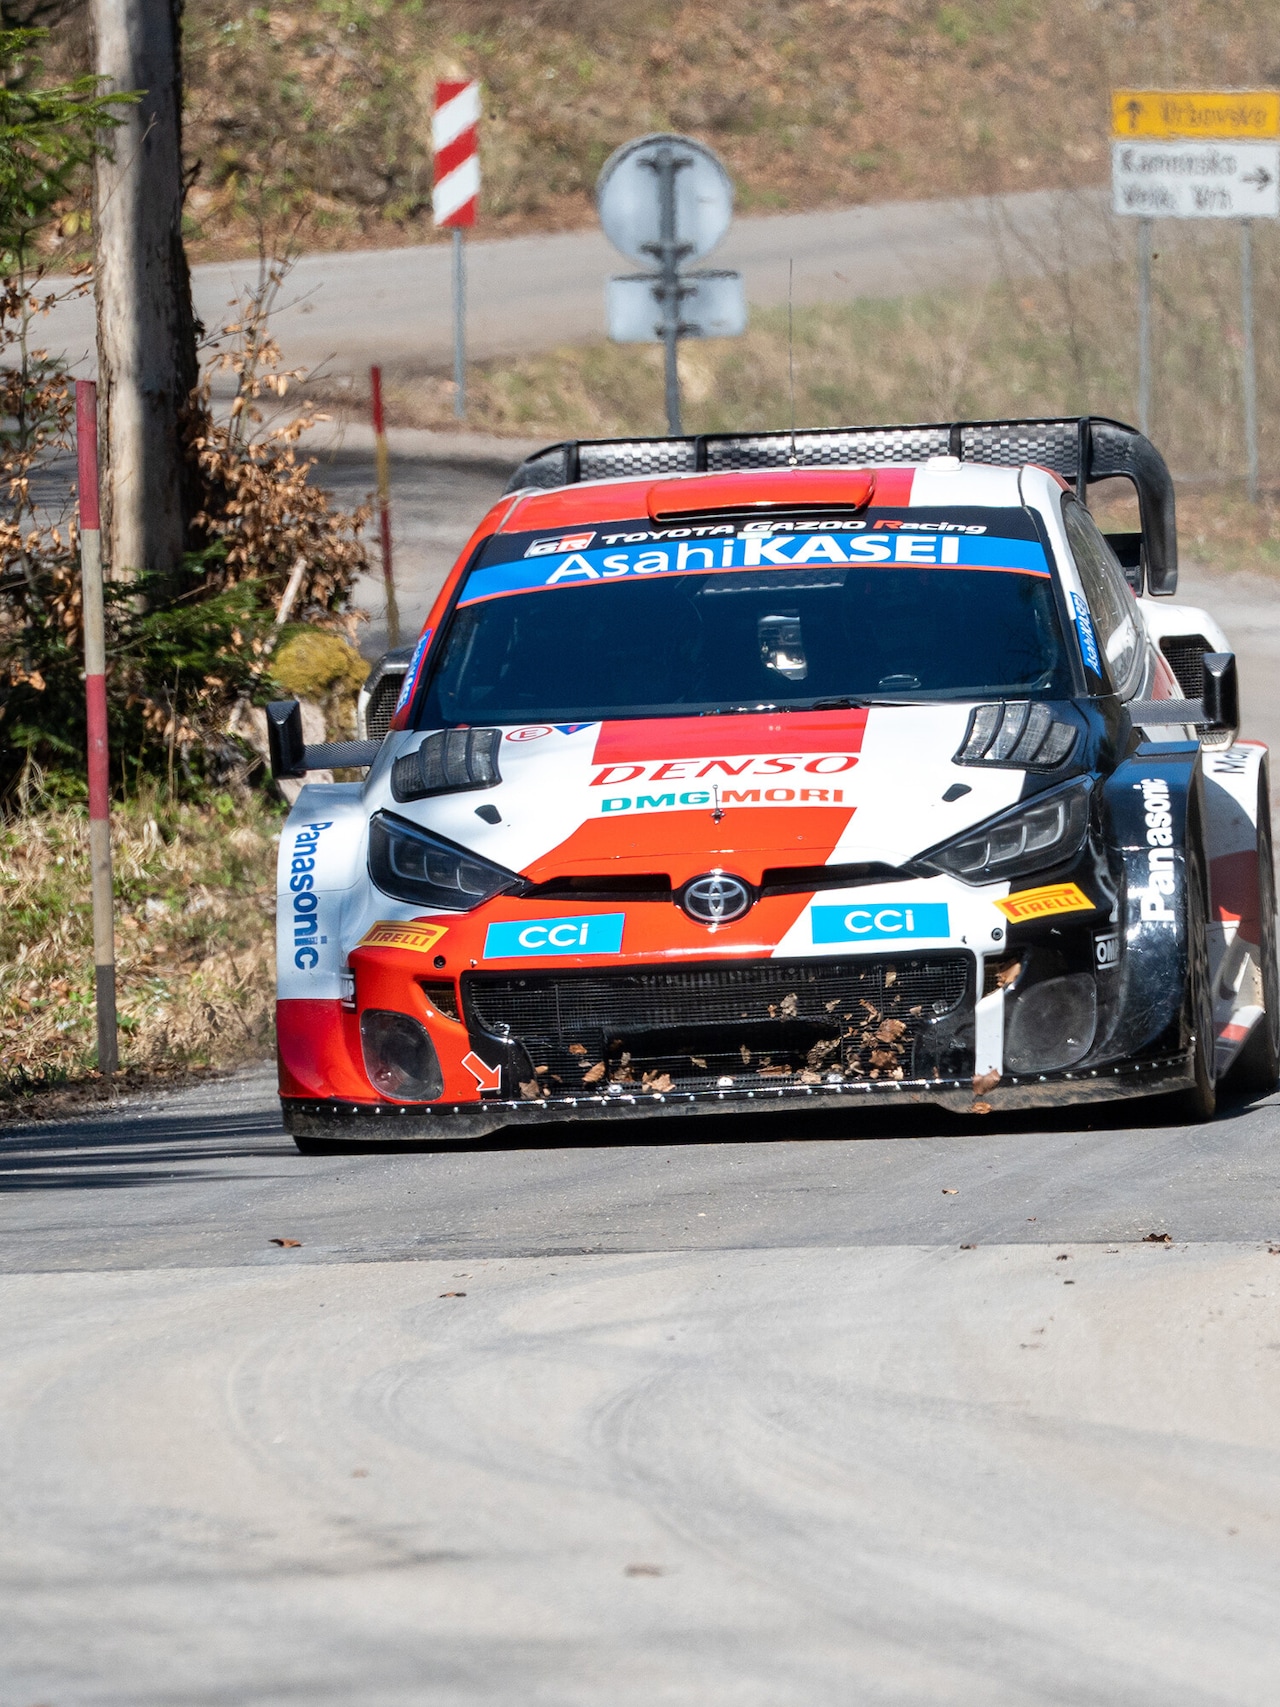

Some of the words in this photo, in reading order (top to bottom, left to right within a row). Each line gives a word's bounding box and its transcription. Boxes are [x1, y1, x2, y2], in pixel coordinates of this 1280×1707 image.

[528, 534, 591, 556] GR
[602, 524, 735, 545] TOYOTA
[872, 519, 988, 535] Racing
[588, 756, 859, 787] DENSO
[601, 791, 711, 813] DMG
[720, 788, 844, 804] MORI
[1132, 778, 1176, 922] Panasonic
[289, 821, 334, 971] Panasonic
[1001, 888, 1085, 917] PIRELLI
[364, 924, 438, 947] PIRELLI
